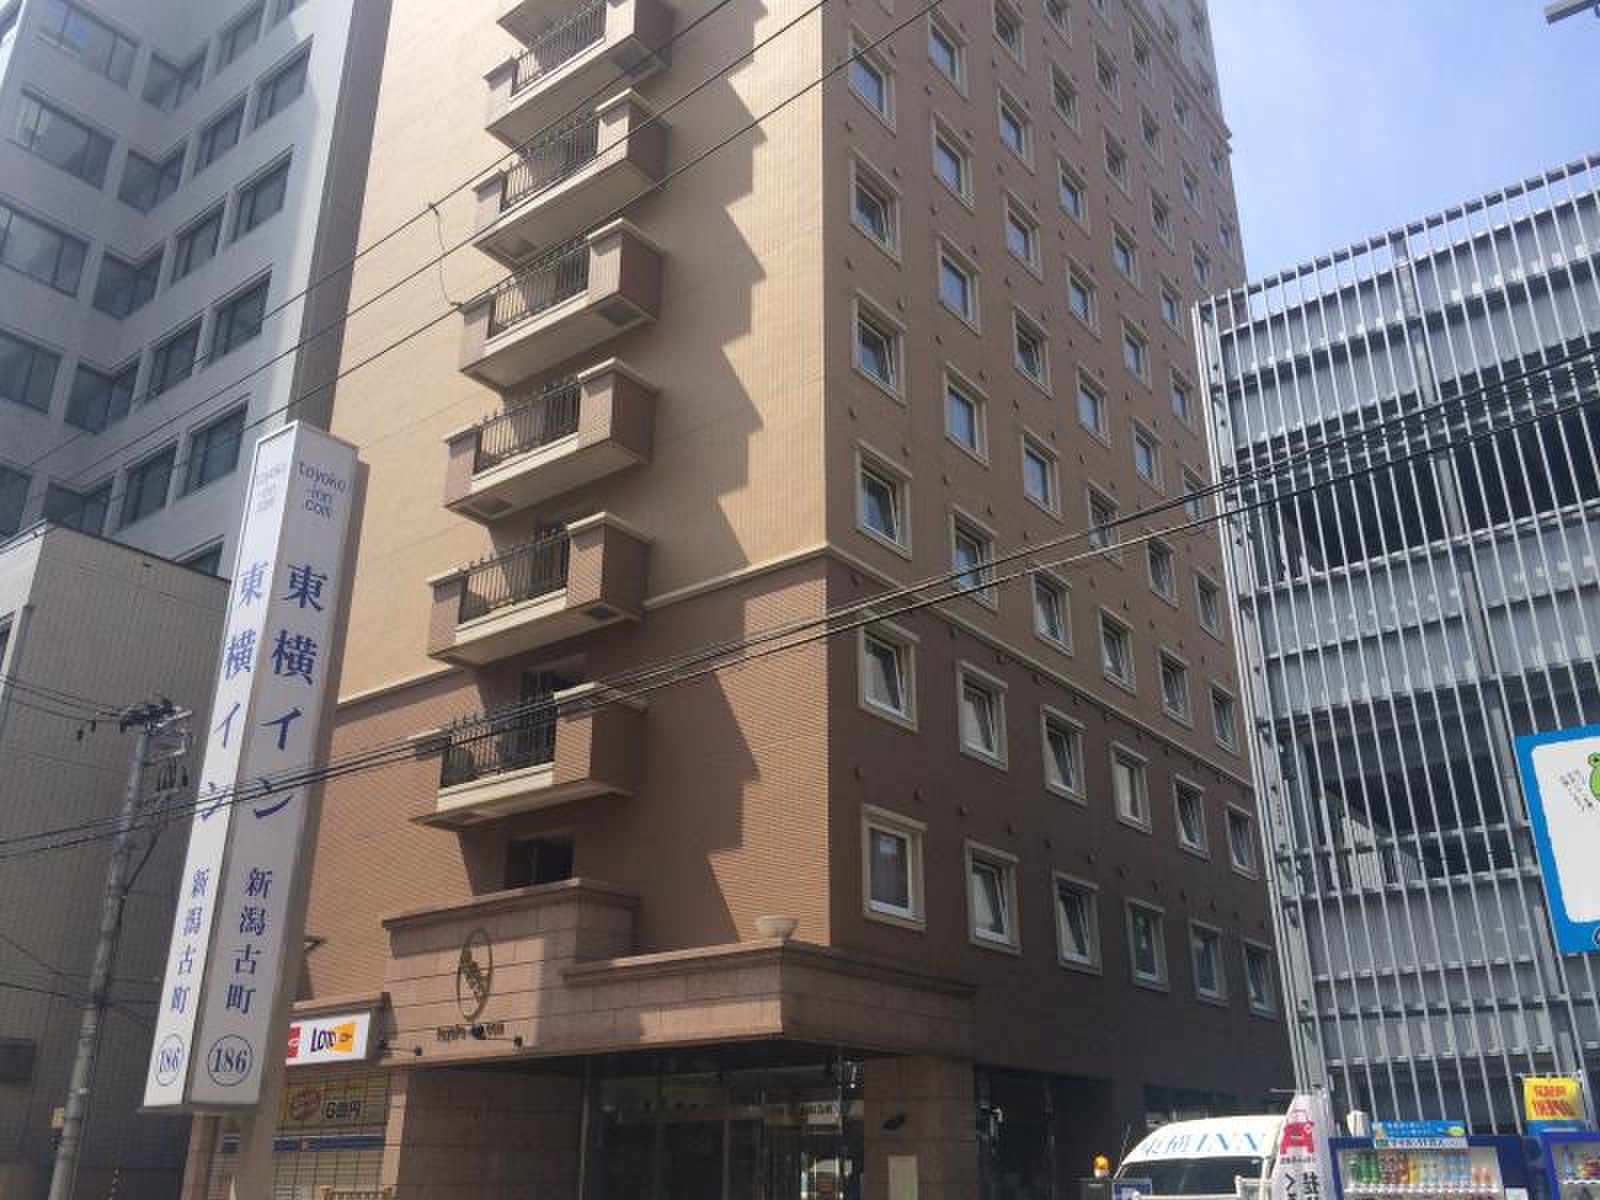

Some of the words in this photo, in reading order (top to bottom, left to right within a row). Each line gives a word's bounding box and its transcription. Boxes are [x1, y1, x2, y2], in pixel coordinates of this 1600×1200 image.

[201, 562, 269, 820] 東横イン
[254, 564, 329, 818] 東横イン
[225, 867, 273, 1014] 新潟古町
[211, 1048, 247, 1072] 186
